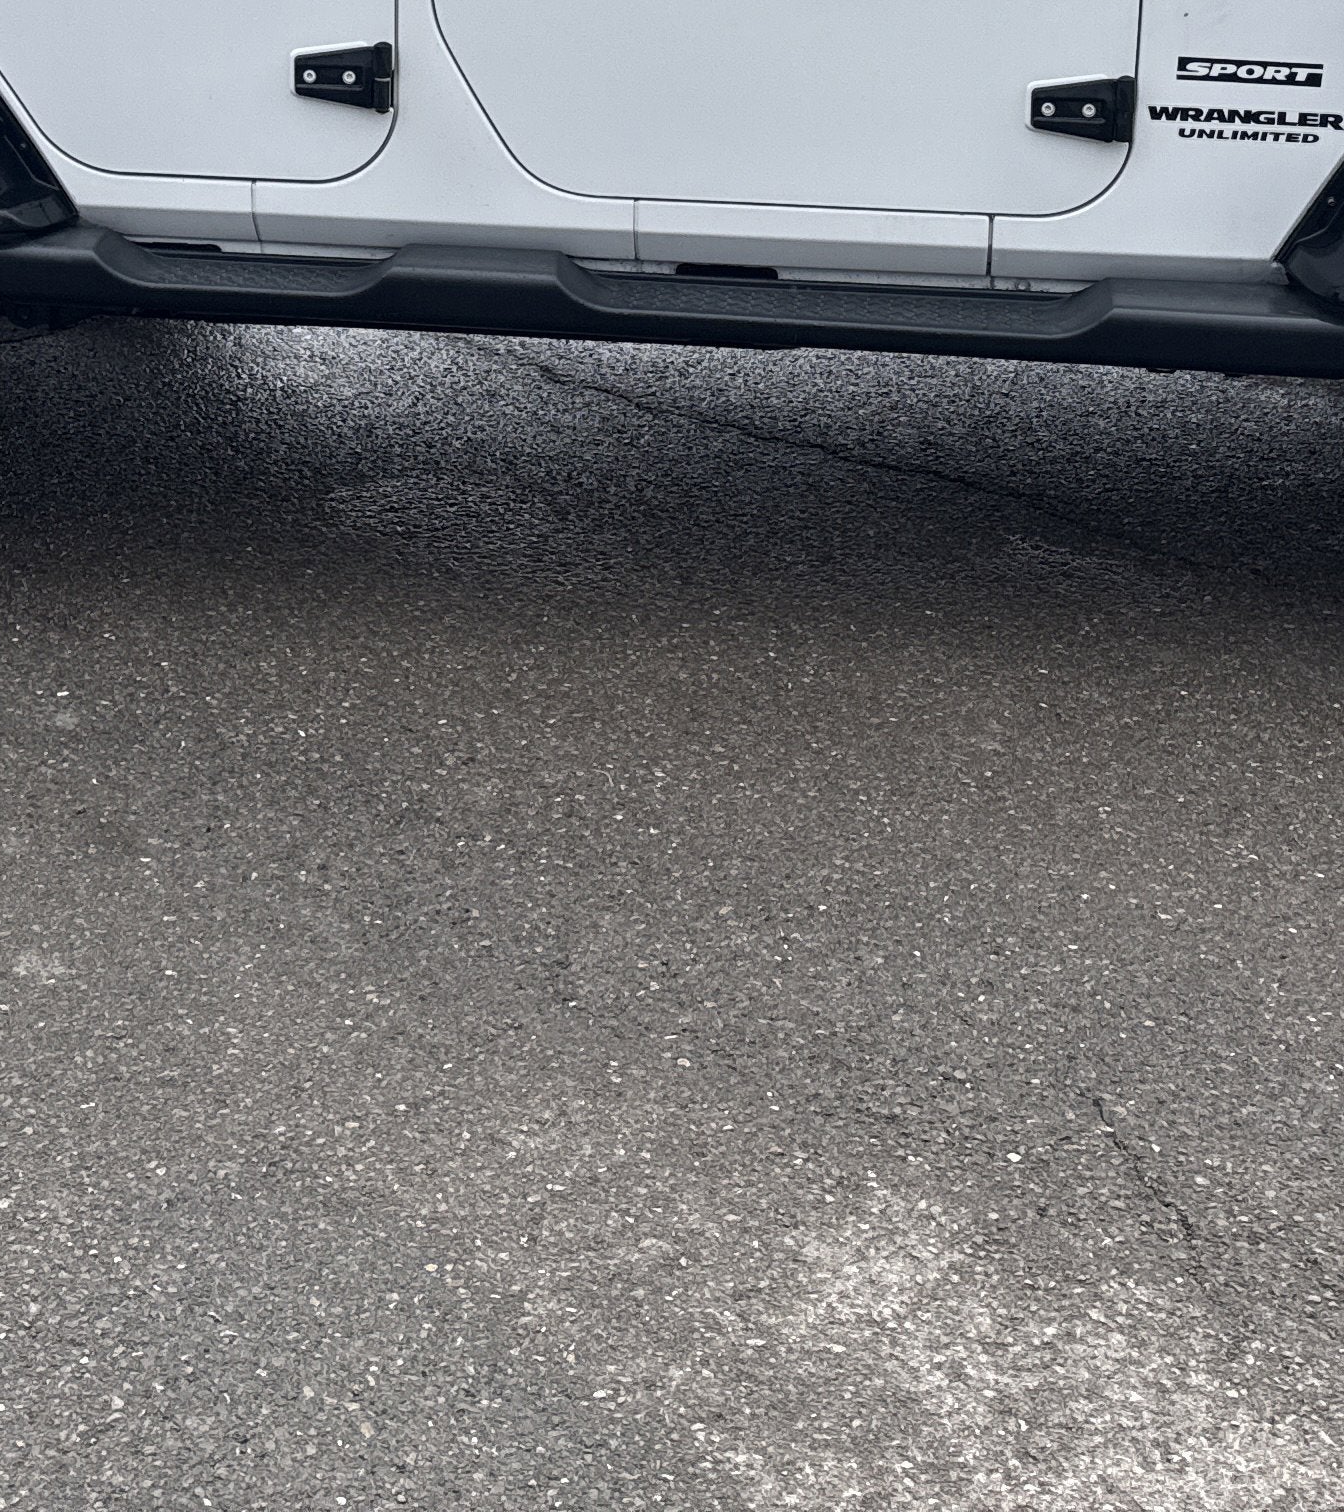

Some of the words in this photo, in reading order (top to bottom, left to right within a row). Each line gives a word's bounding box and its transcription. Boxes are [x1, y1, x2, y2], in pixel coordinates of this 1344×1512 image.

[1186, 61, 1319, 81] SPORT
[1148, 106, 1344, 130] WRANGLER
[1179, 128, 1319, 143] UNLIMITED
